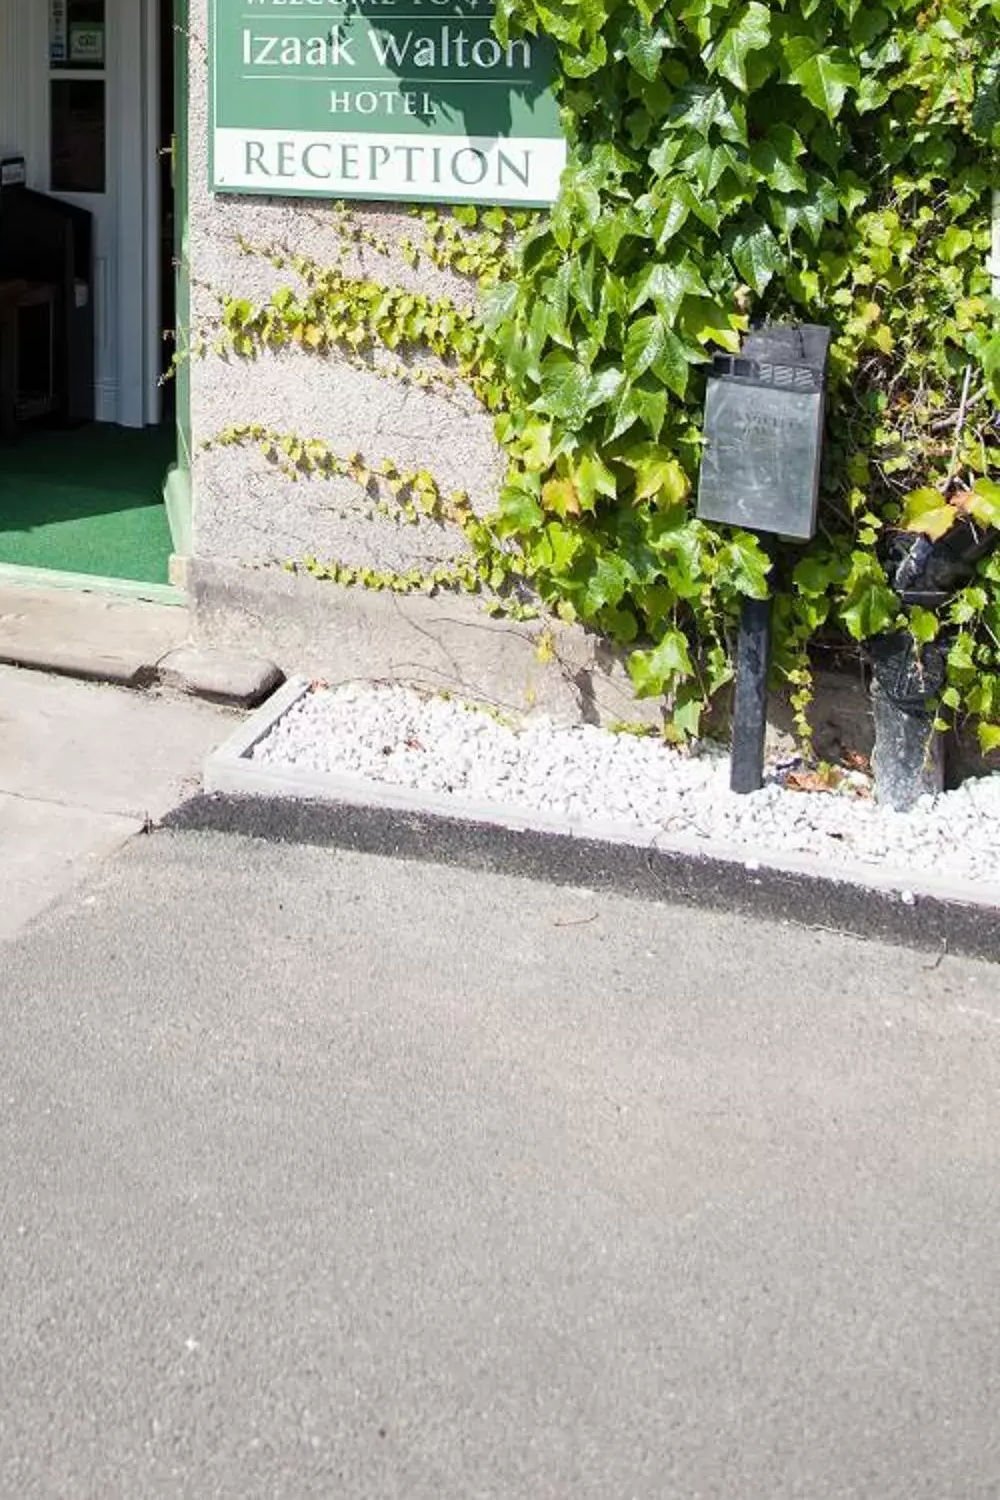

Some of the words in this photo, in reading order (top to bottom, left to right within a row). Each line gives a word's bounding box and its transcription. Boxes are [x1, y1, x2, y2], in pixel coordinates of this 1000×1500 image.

[243, 27, 356, 67] Izaak
[368, 26, 532, 69] Walton
[329, 91, 436, 116] HOTEL
[244, 141, 534, 188] RECEPTION
